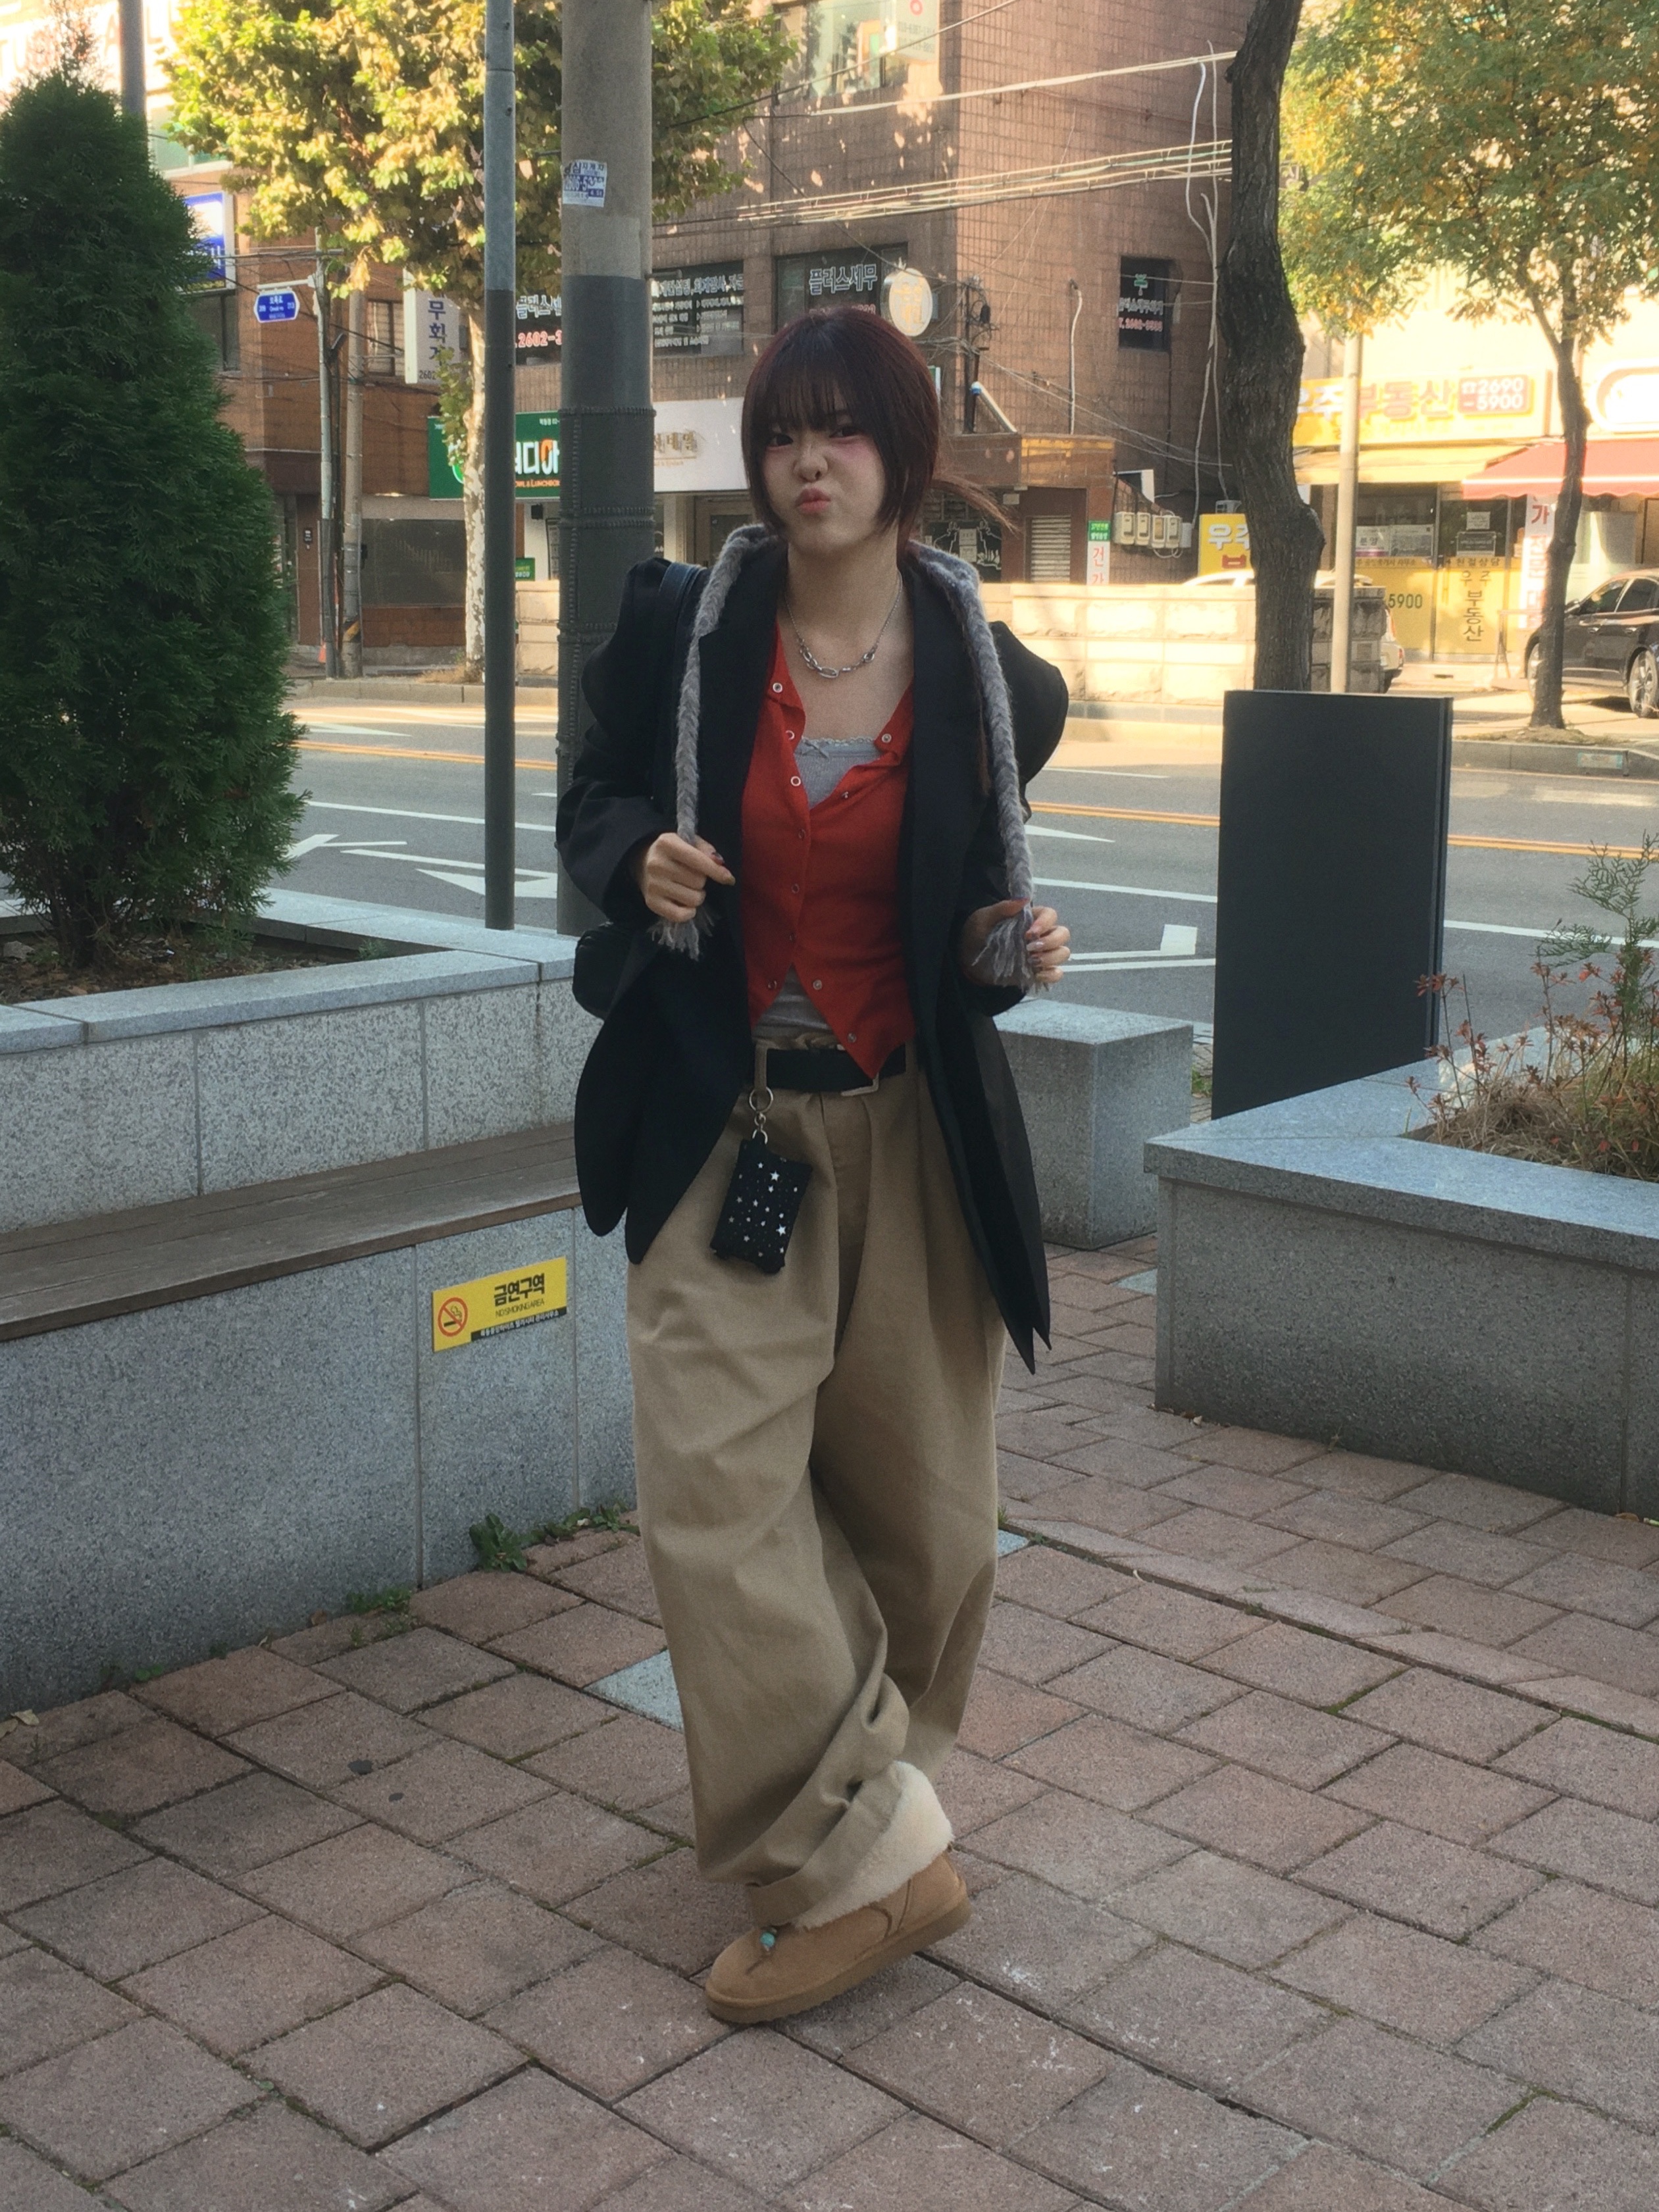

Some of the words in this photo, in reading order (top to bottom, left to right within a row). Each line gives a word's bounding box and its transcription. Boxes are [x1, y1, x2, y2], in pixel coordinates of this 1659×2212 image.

[809, 264, 878, 295] 플러스세무
[1477, 378, 1524, 396] 2690
[1456, 558, 1500, 566] 친절상담
[1460, 570, 1492, 587] 우주
[1388, 593, 1423, 609] 5900
[1463, 589, 1485, 642] 부동산
[494, 1273, 545, 1307] 금연구역
